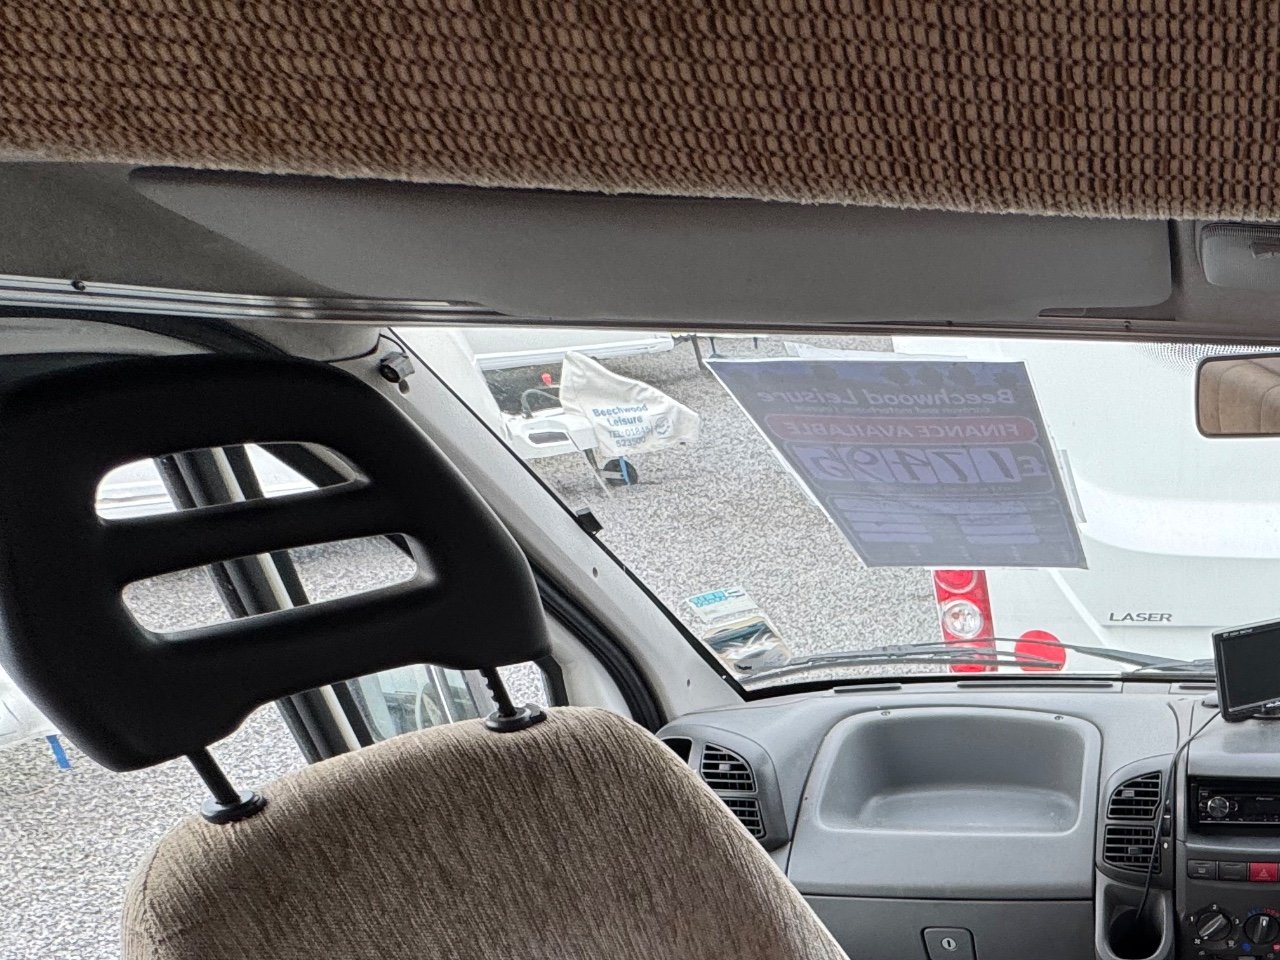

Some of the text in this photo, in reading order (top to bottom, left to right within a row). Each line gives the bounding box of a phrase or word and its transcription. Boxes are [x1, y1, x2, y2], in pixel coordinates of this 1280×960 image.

[592, 403, 648, 417] Beechwood
[607, 415, 643, 427] Leisure
[1109, 611, 1173, 623] LASER
